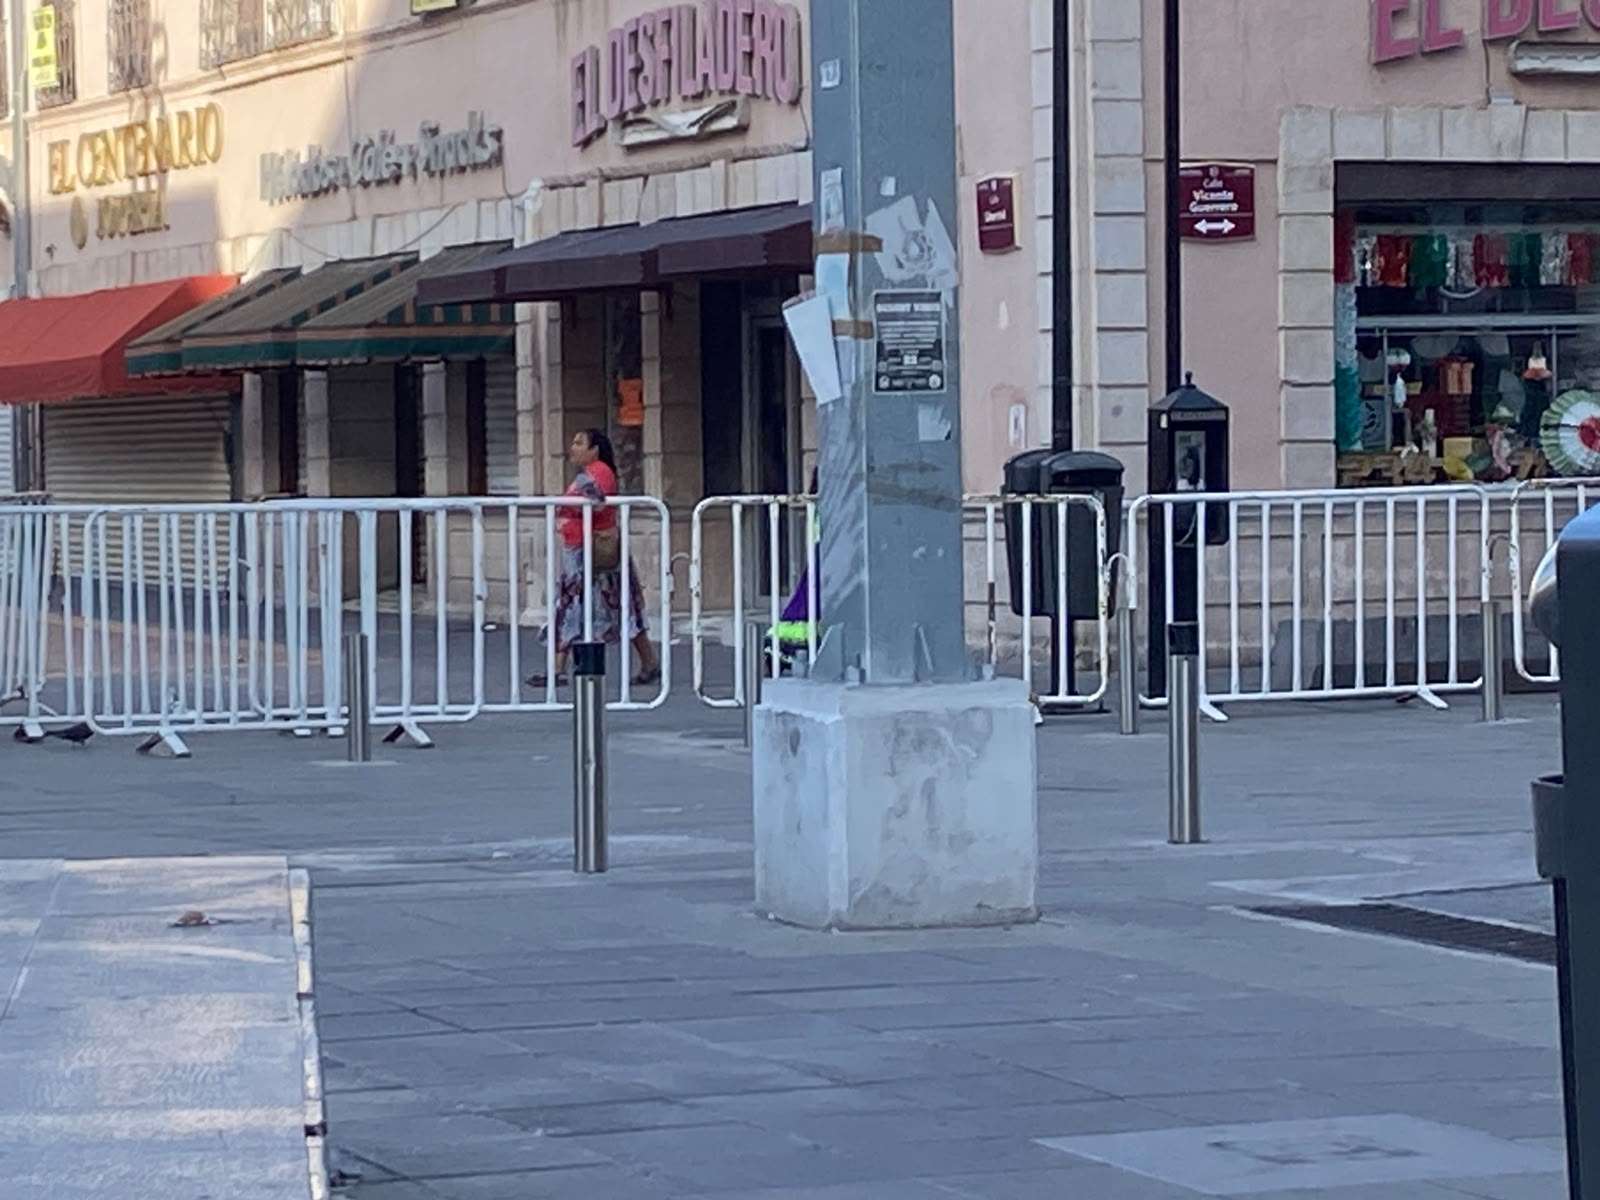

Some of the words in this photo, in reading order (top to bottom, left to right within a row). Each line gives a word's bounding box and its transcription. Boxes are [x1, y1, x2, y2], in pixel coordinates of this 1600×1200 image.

[571, 45, 606, 149] EL
[606, 0, 801, 121] DESFILADERO
[48, 140, 75, 195] EL
[77, 102, 223, 187] CENTENARIO
